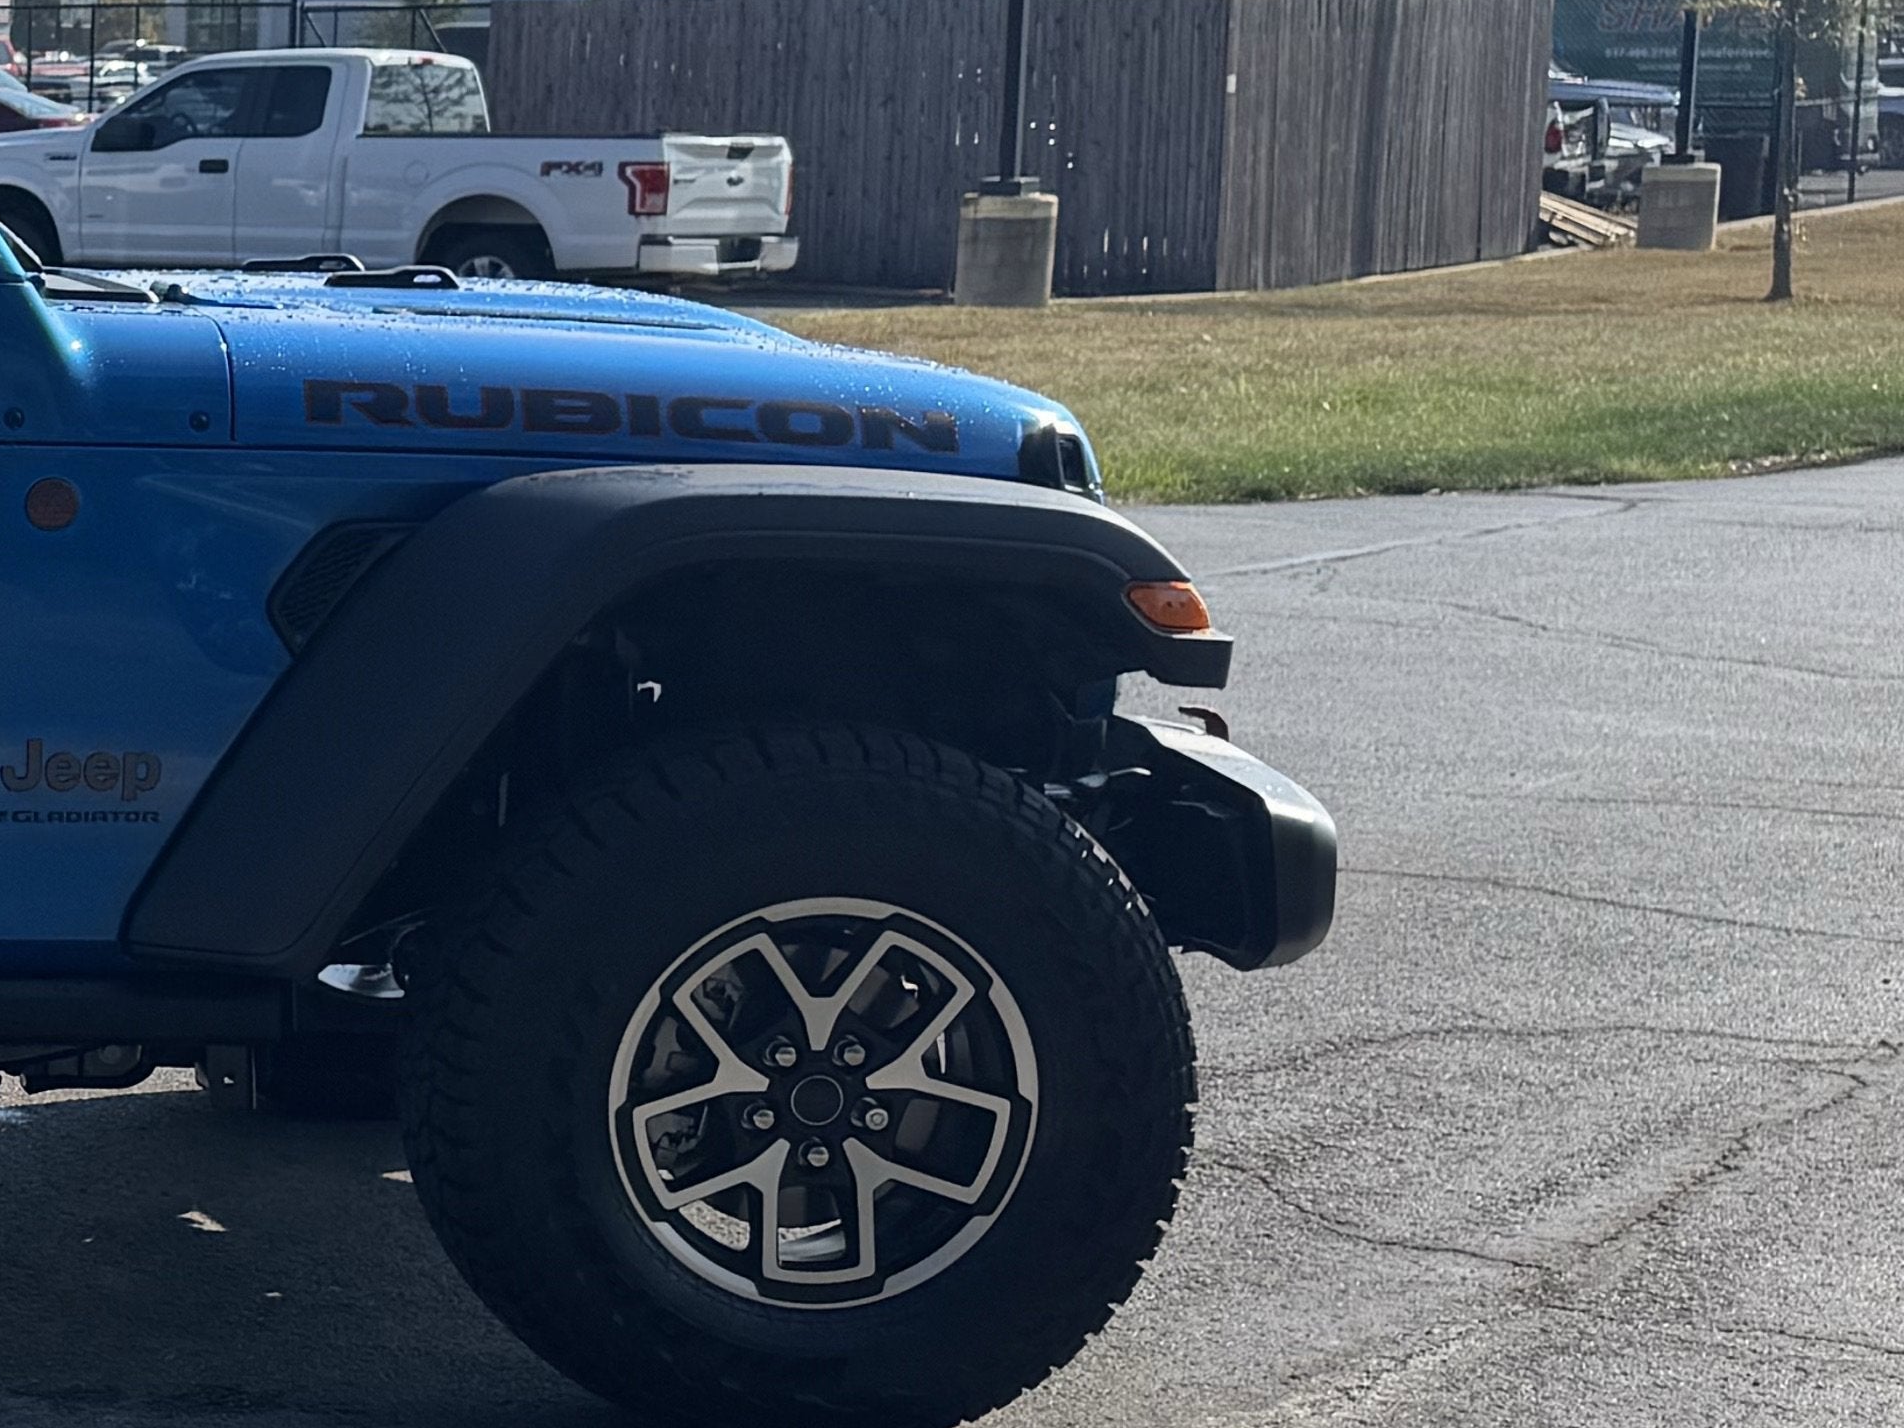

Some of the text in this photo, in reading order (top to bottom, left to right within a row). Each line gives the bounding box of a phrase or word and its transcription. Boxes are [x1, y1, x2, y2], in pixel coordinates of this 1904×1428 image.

[540, 161, 603, 178] FX4
[302, 378, 960, 453] RUBICON
[0, 737, 162, 802] Jeep
[11, 810, 162, 823] GLADIATOR
